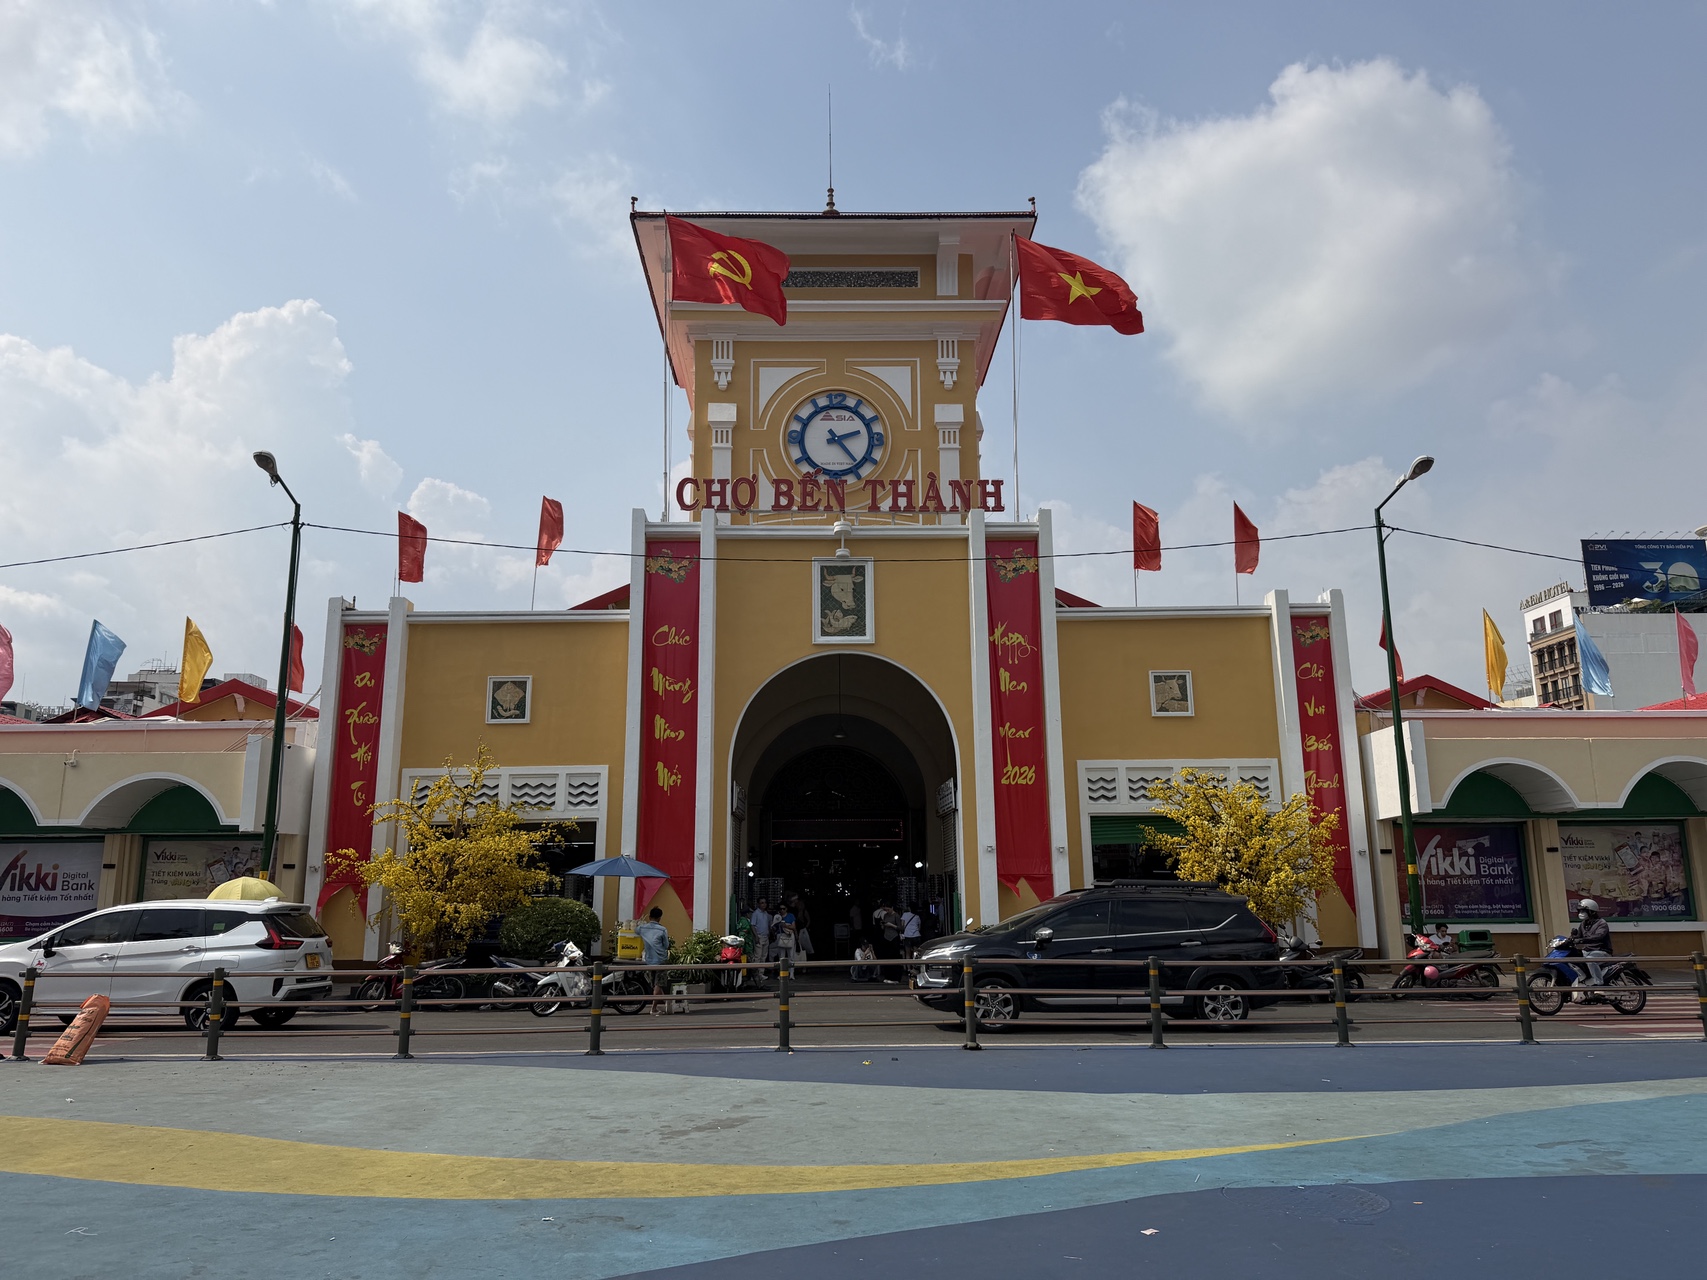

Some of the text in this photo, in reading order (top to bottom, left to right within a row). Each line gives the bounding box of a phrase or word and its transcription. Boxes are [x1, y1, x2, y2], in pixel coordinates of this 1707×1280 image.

[826, 393, 847, 407] 12
[788, 430, 800, 445] 9
[676, 468, 1005, 515] CHỢ BẾN THÀNH
[1593, 573, 1608, 581] KHÔNG
[1544, 581, 1569, 601] HOTEL
[1593, 583, 1605, 591] 1996
[652, 625, 692, 646] Chúc
[989, 620, 1037, 664] Happy
[1297, 662, 1325, 682] Chợ
[651, 667, 697, 704] Mừng
[1304, 695, 1325, 717] Vui
[999, 722, 1034, 767] Year
[1304, 733, 1333, 752] Bến
[655, 761, 681, 796] Mới
[1001, 765, 1036, 784] 2026
[1304, 770, 1340, 795] Thành
[1560, 833, 1583, 845] Vikki
[153, 848, 177, 860] Vikki
[1479, 856, 1504, 864] Digital
[62, 872, 89, 880] Digital
[1481, 864, 1513, 875] Bank
[61, 880, 95, 891] Bank
[1427, 878, 1445, 886] hàng
[1463, 878, 1480, 886] kiệm
[2, 893, 94, 903] hàng Tiết kiệm Tốt nhất!
